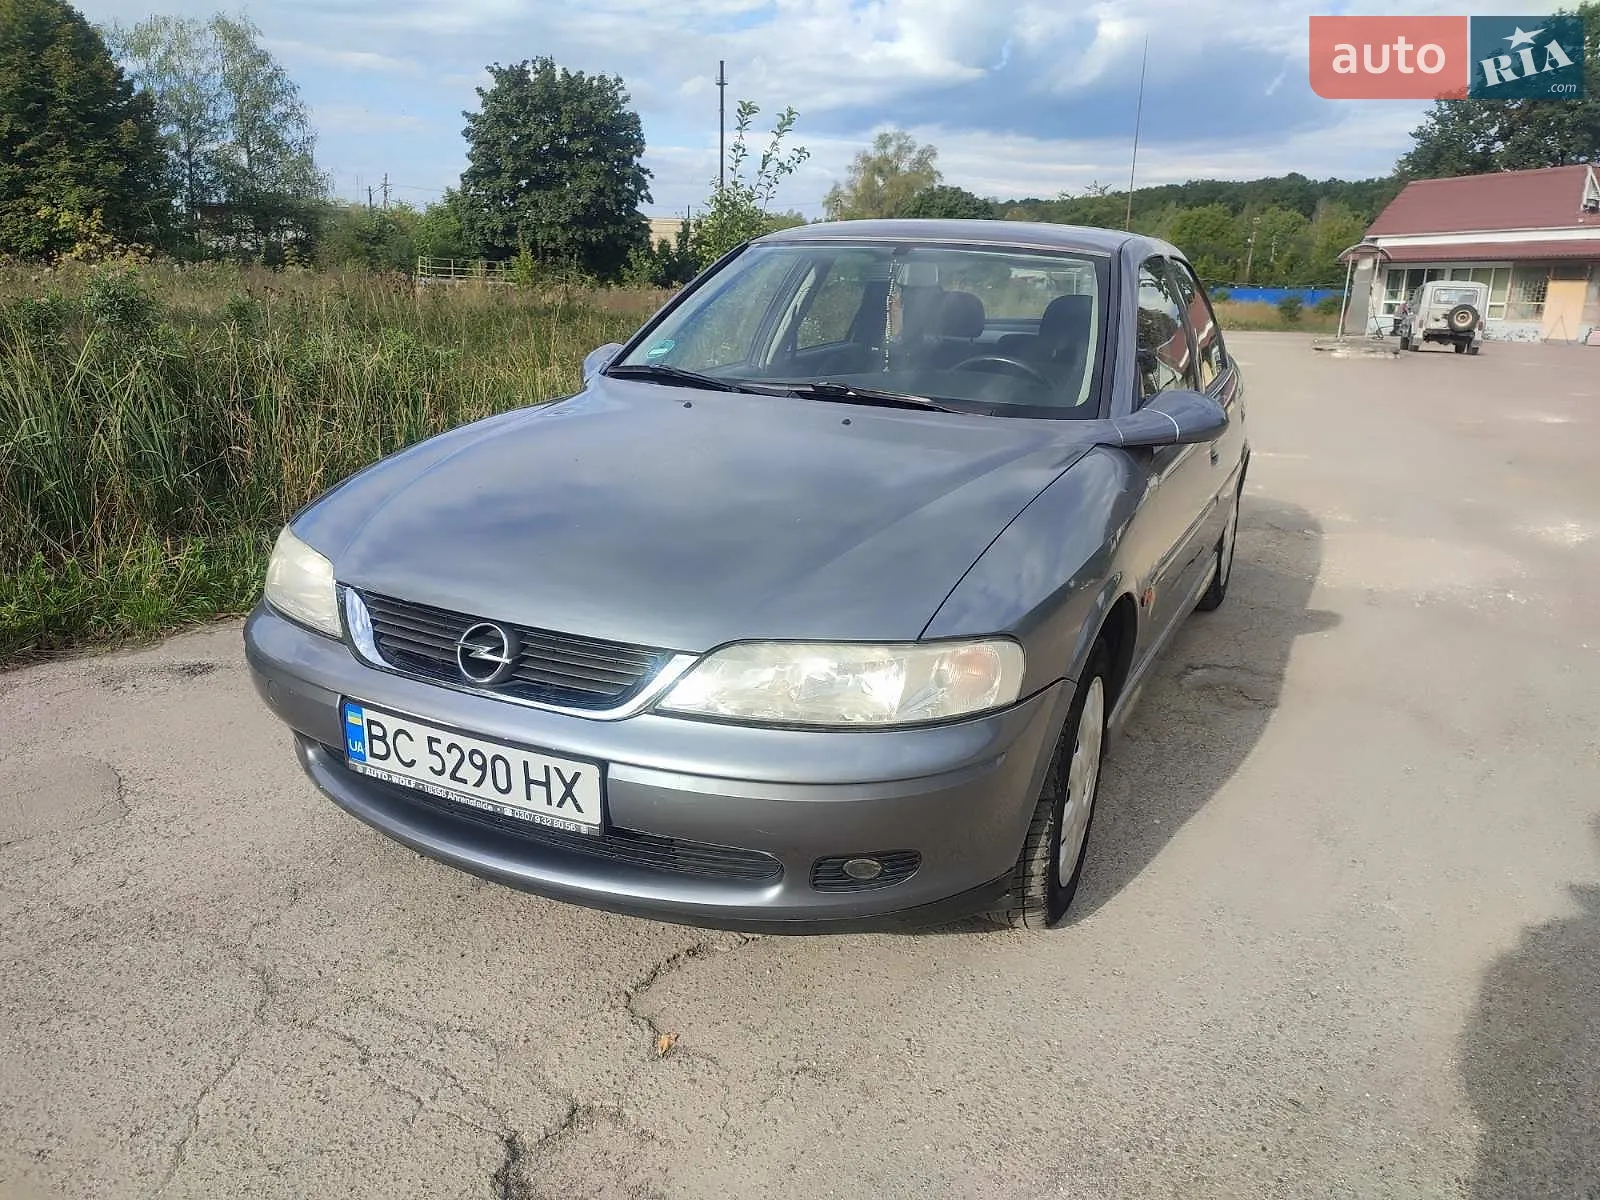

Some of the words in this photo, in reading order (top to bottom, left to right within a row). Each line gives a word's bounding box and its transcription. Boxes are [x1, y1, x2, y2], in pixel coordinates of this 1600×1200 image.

[349, 738, 365, 754] UA
[366, 718, 417, 769] BC
[426, 735, 513, 796] 5290
[522, 760, 585, 814] HX
